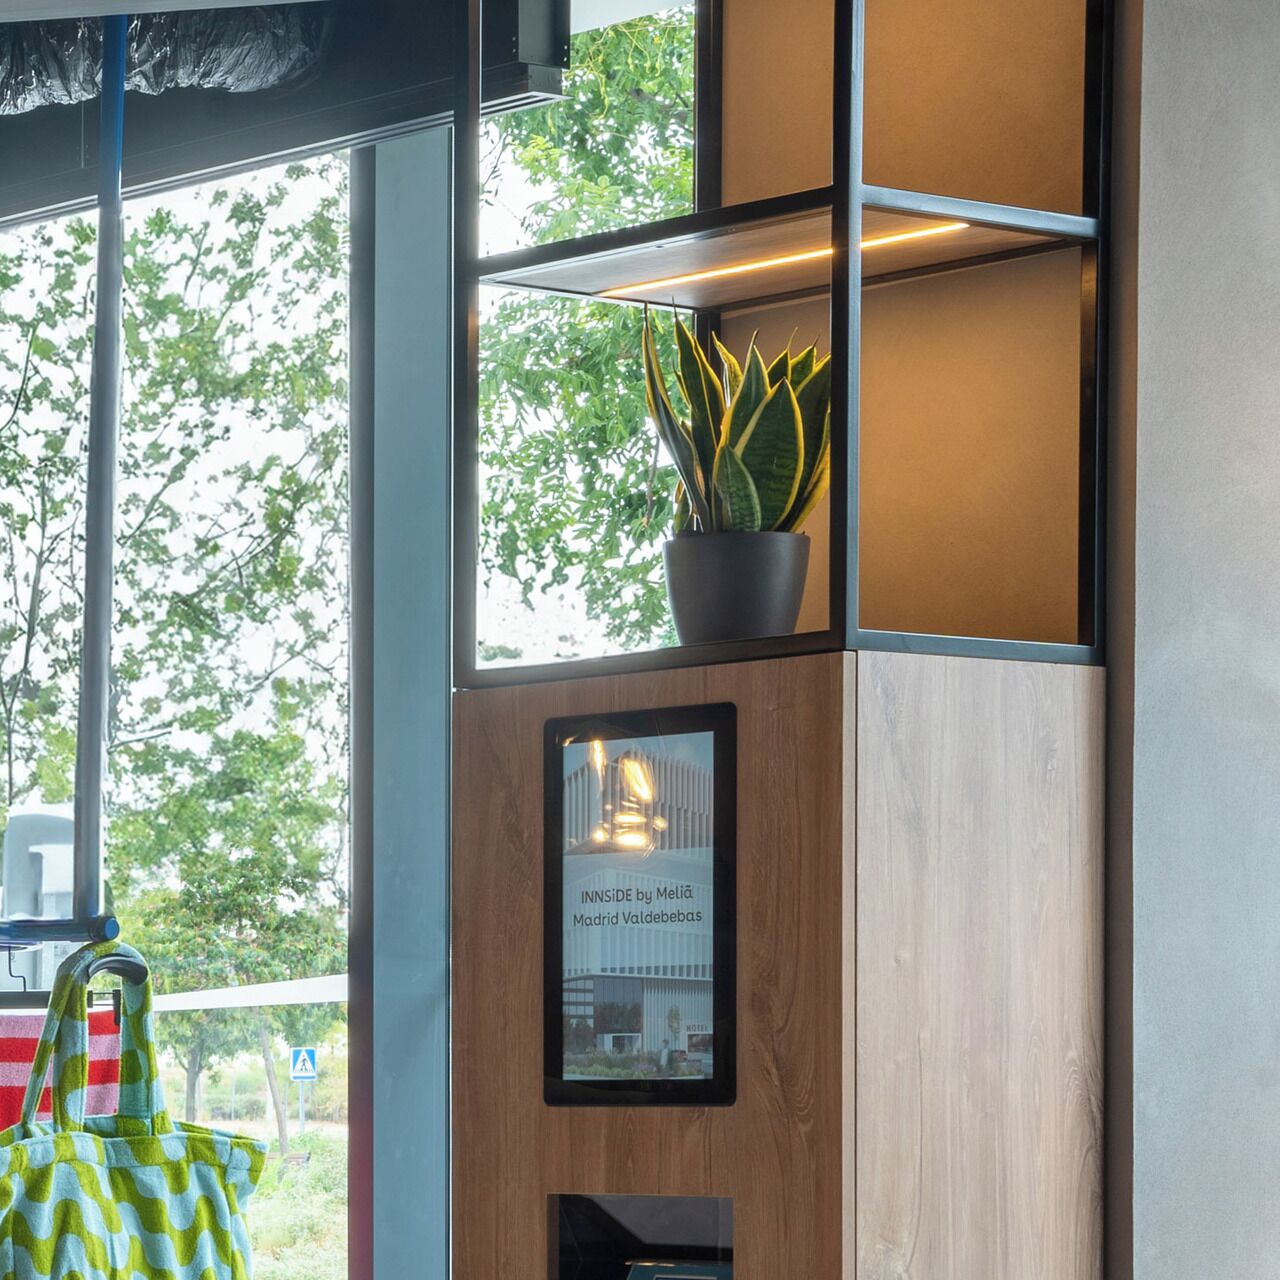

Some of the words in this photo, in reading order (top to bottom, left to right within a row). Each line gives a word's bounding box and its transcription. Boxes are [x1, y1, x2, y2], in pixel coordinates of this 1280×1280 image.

[581, 889, 632, 904] INNSiDE
[636, 889, 653, 905] by
[573, 912, 619, 927] Madrid
[622, 909, 703, 924] Valdebebas
[686, 1024, 708, 1032] HOTEL
